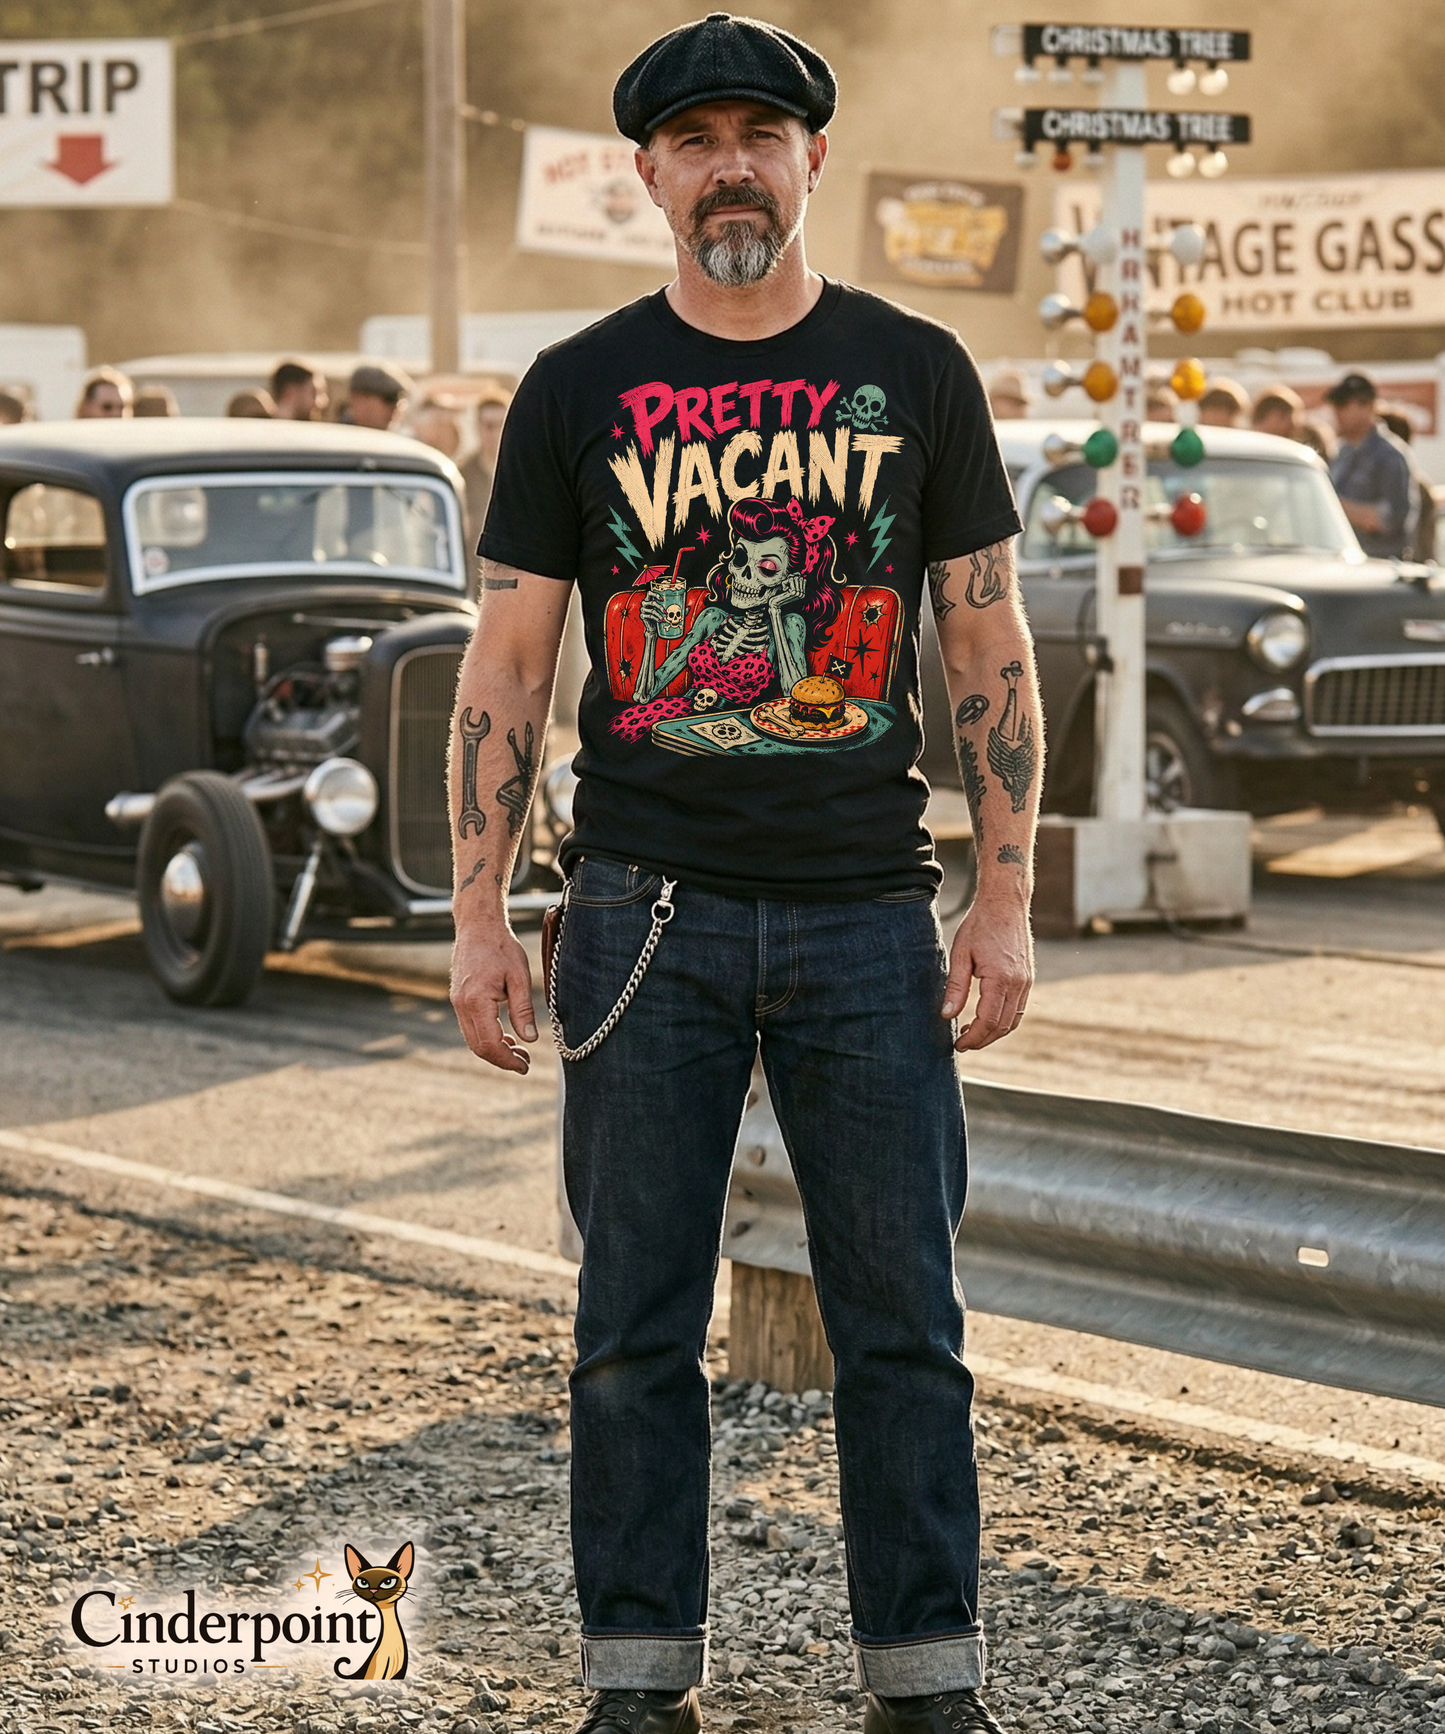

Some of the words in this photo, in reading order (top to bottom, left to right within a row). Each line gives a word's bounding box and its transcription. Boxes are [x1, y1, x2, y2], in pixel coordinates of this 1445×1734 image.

[1040, 25, 1172, 56] CHRISTMAS
[1177, 29, 1234, 58] TREE
[1041, 110, 1172, 140] CHRISTMAS
[1177, 114, 1234, 142] TREE
[1072, 204, 1296, 294] VTAGE
[1221, 290, 1296, 316] HOT
[1312, 288, 1413, 313] CLUB
[617, 379, 841, 459] PRETTY
[607, 425, 905, 552] VACANT
